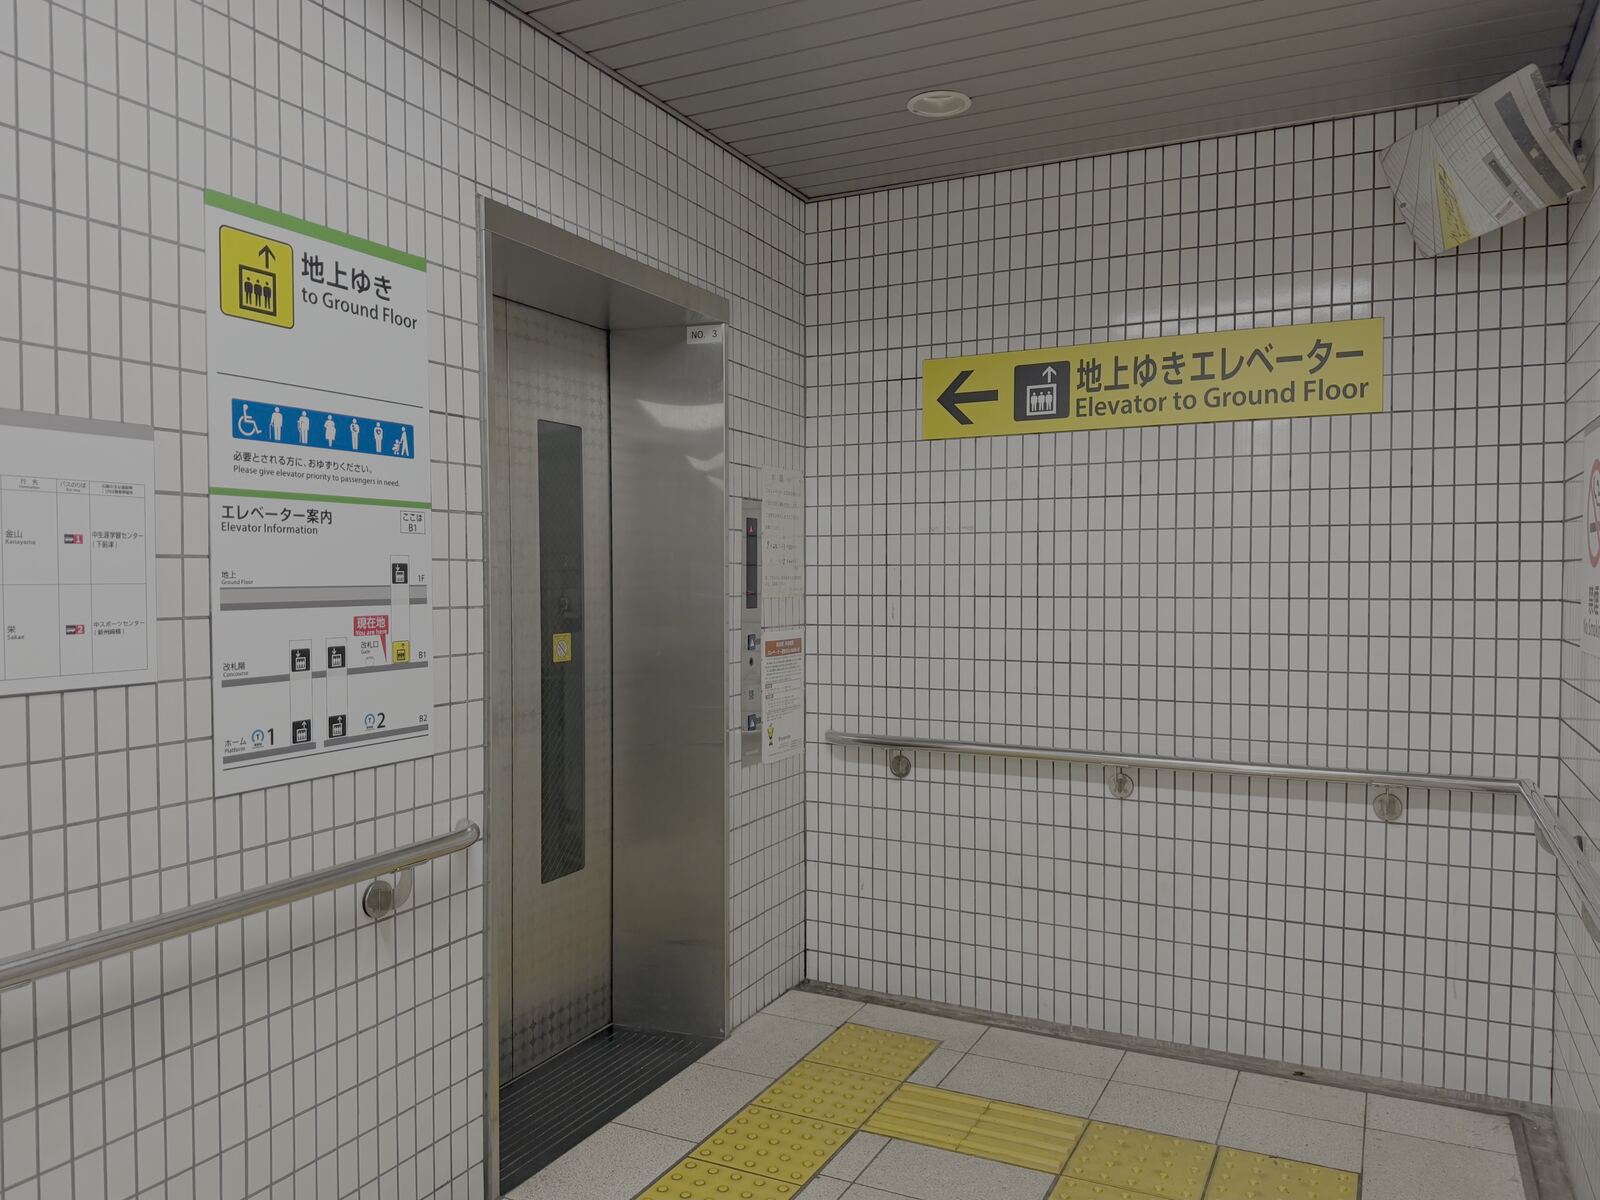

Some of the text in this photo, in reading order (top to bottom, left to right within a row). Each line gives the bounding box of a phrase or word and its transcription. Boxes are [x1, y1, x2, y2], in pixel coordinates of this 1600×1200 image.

[301, 252, 392, 301] 地上ゆき
[301, 287, 418, 330] to Ground Floor
[712, 329, 718, 338] 3
[1076, 338, 1364, 394] 地上ゆきエレベーター
[1075, 377, 1369, 418] Elevator to Ground Floor
[233, 451, 374, 474] 必要とされる方に、おゆずりください。
[233, 464, 401, 488] Please give elevator priority to passengers in need.
[221, 504, 333, 526] エレベーター案内
[402, 513, 424, 523] ここは
[5, 529, 23, 539] 金山
[221, 521, 318, 536] Elevator Information
[408, 523, 417, 533] B1
[221, 570, 237, 580] 地上
[417, 574, 425, 582] 1F
[356, 617, 386, 630] 現在地
[360, 640, 379, 649] 改札口
[418, 651, 427, 659] B1
[376, 712, 386, 729] 2
[418, 714, 428, 723] B2
[224, 737, 247, 748] ホーム
[267, 727, 275, 746] 1
